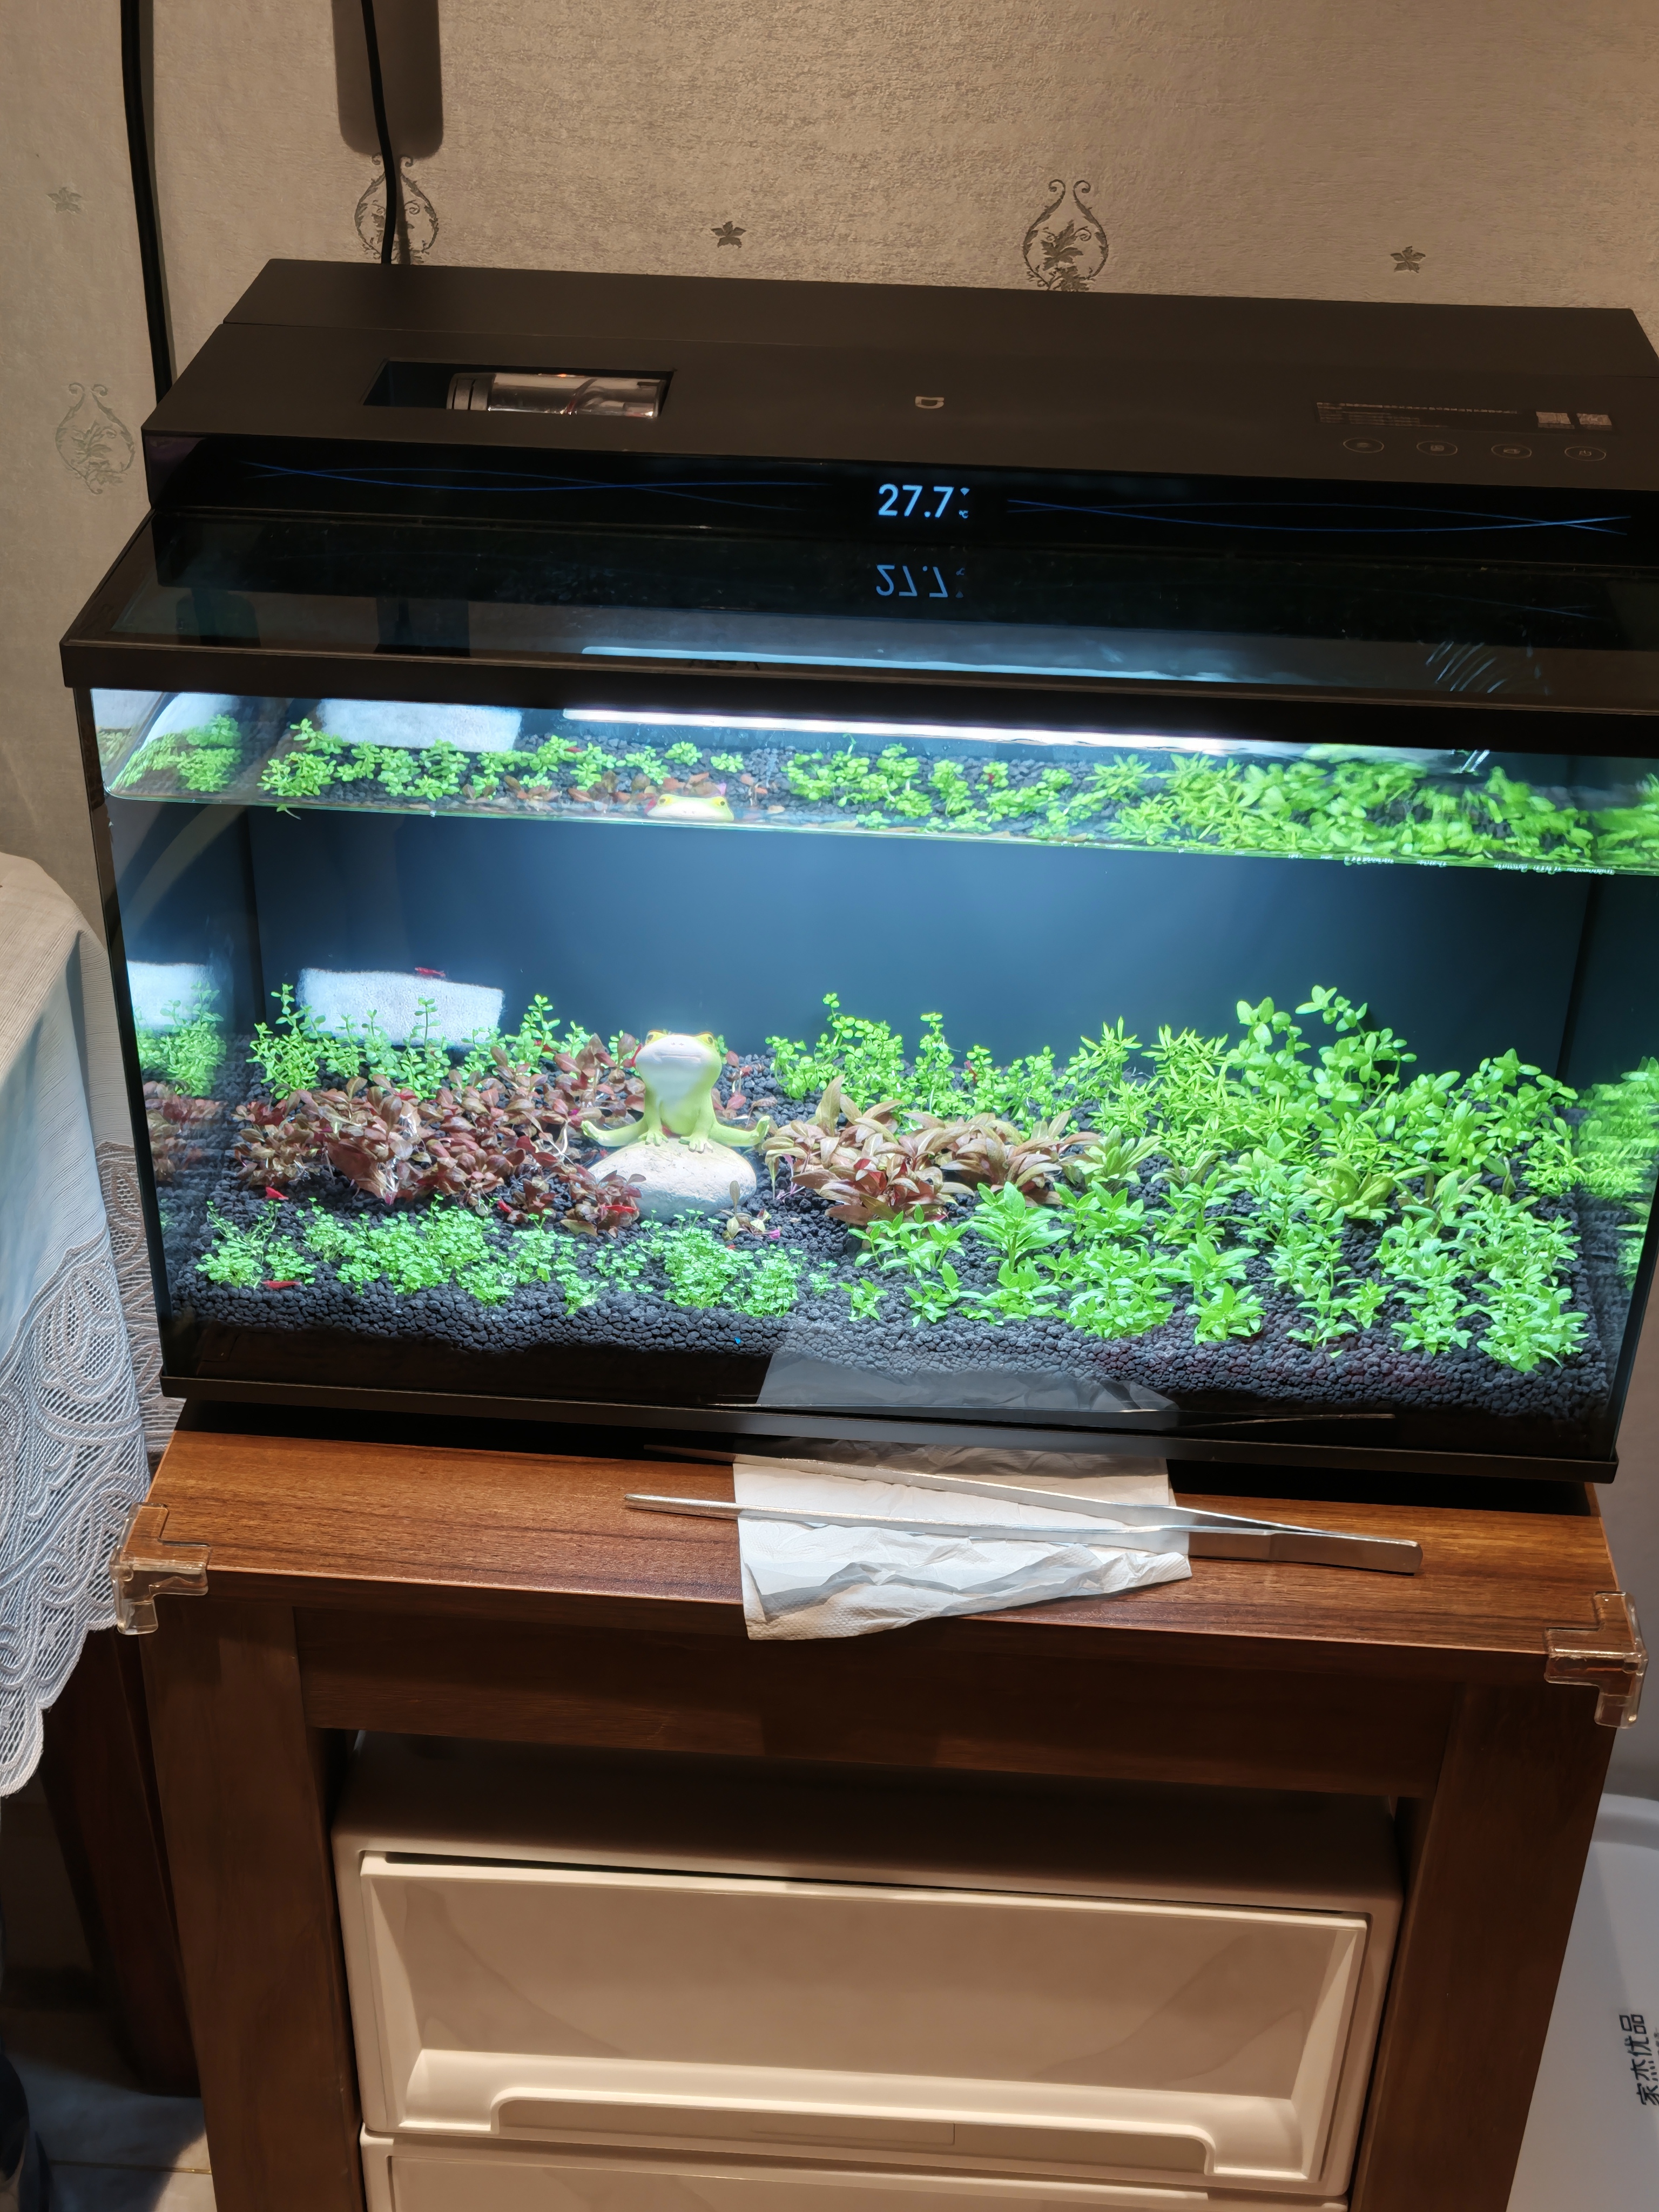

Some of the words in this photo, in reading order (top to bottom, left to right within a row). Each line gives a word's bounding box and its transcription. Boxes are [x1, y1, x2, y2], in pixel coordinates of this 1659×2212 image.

[878, 483, 954, 518] 27.7
[1619, 2013, 1659, 2106] 家杰优品
